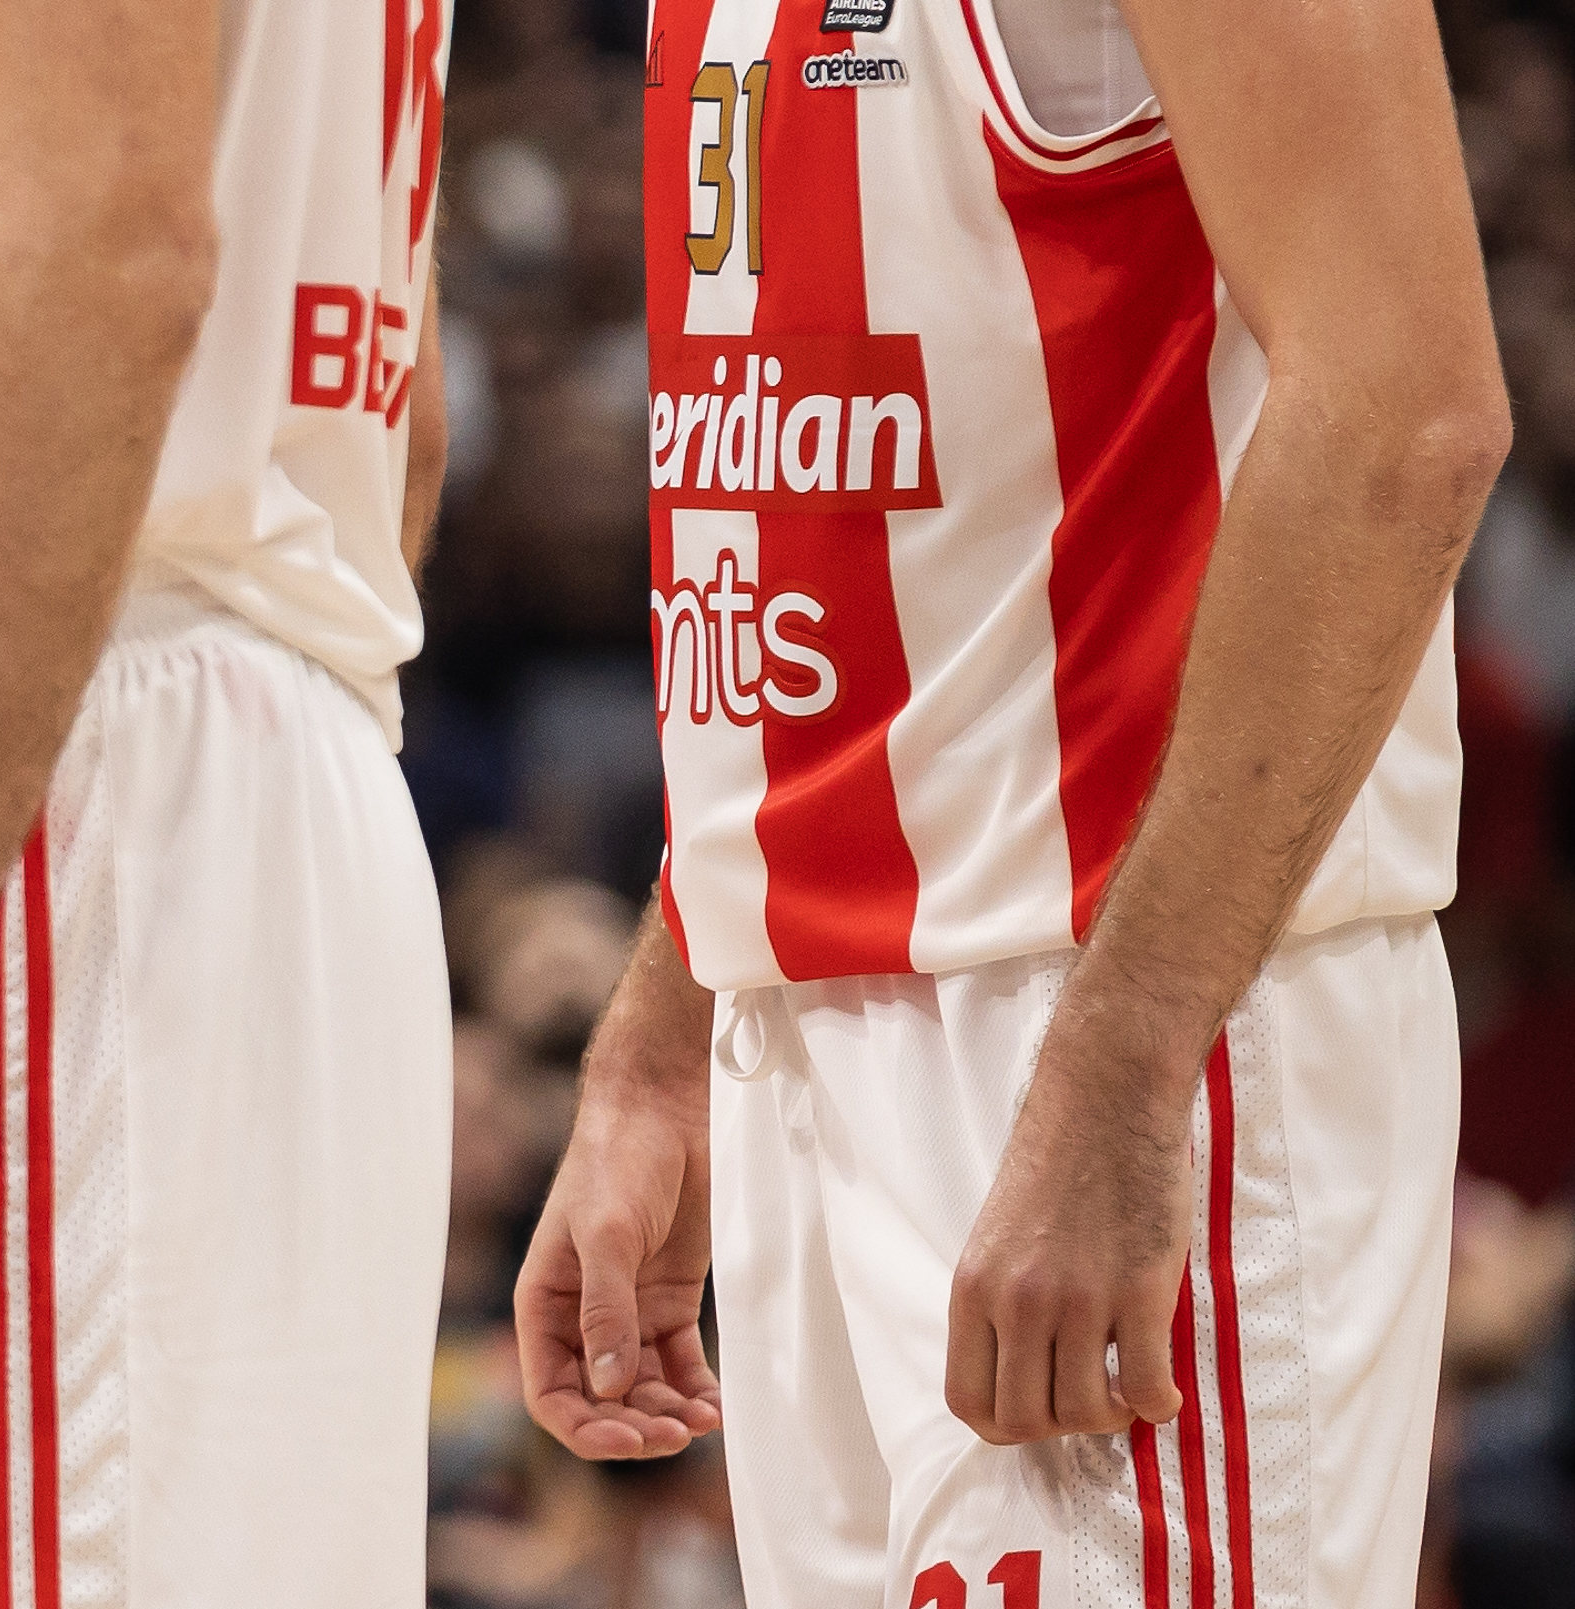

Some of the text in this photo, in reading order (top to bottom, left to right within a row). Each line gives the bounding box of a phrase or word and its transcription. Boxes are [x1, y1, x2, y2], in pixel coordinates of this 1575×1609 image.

[825, 11, 884, 27] EuroLeague
[804, 53, 905, 84] oneteam
[684, 59, 772, 277] 31
[650, 354, 923, 493] eridian
